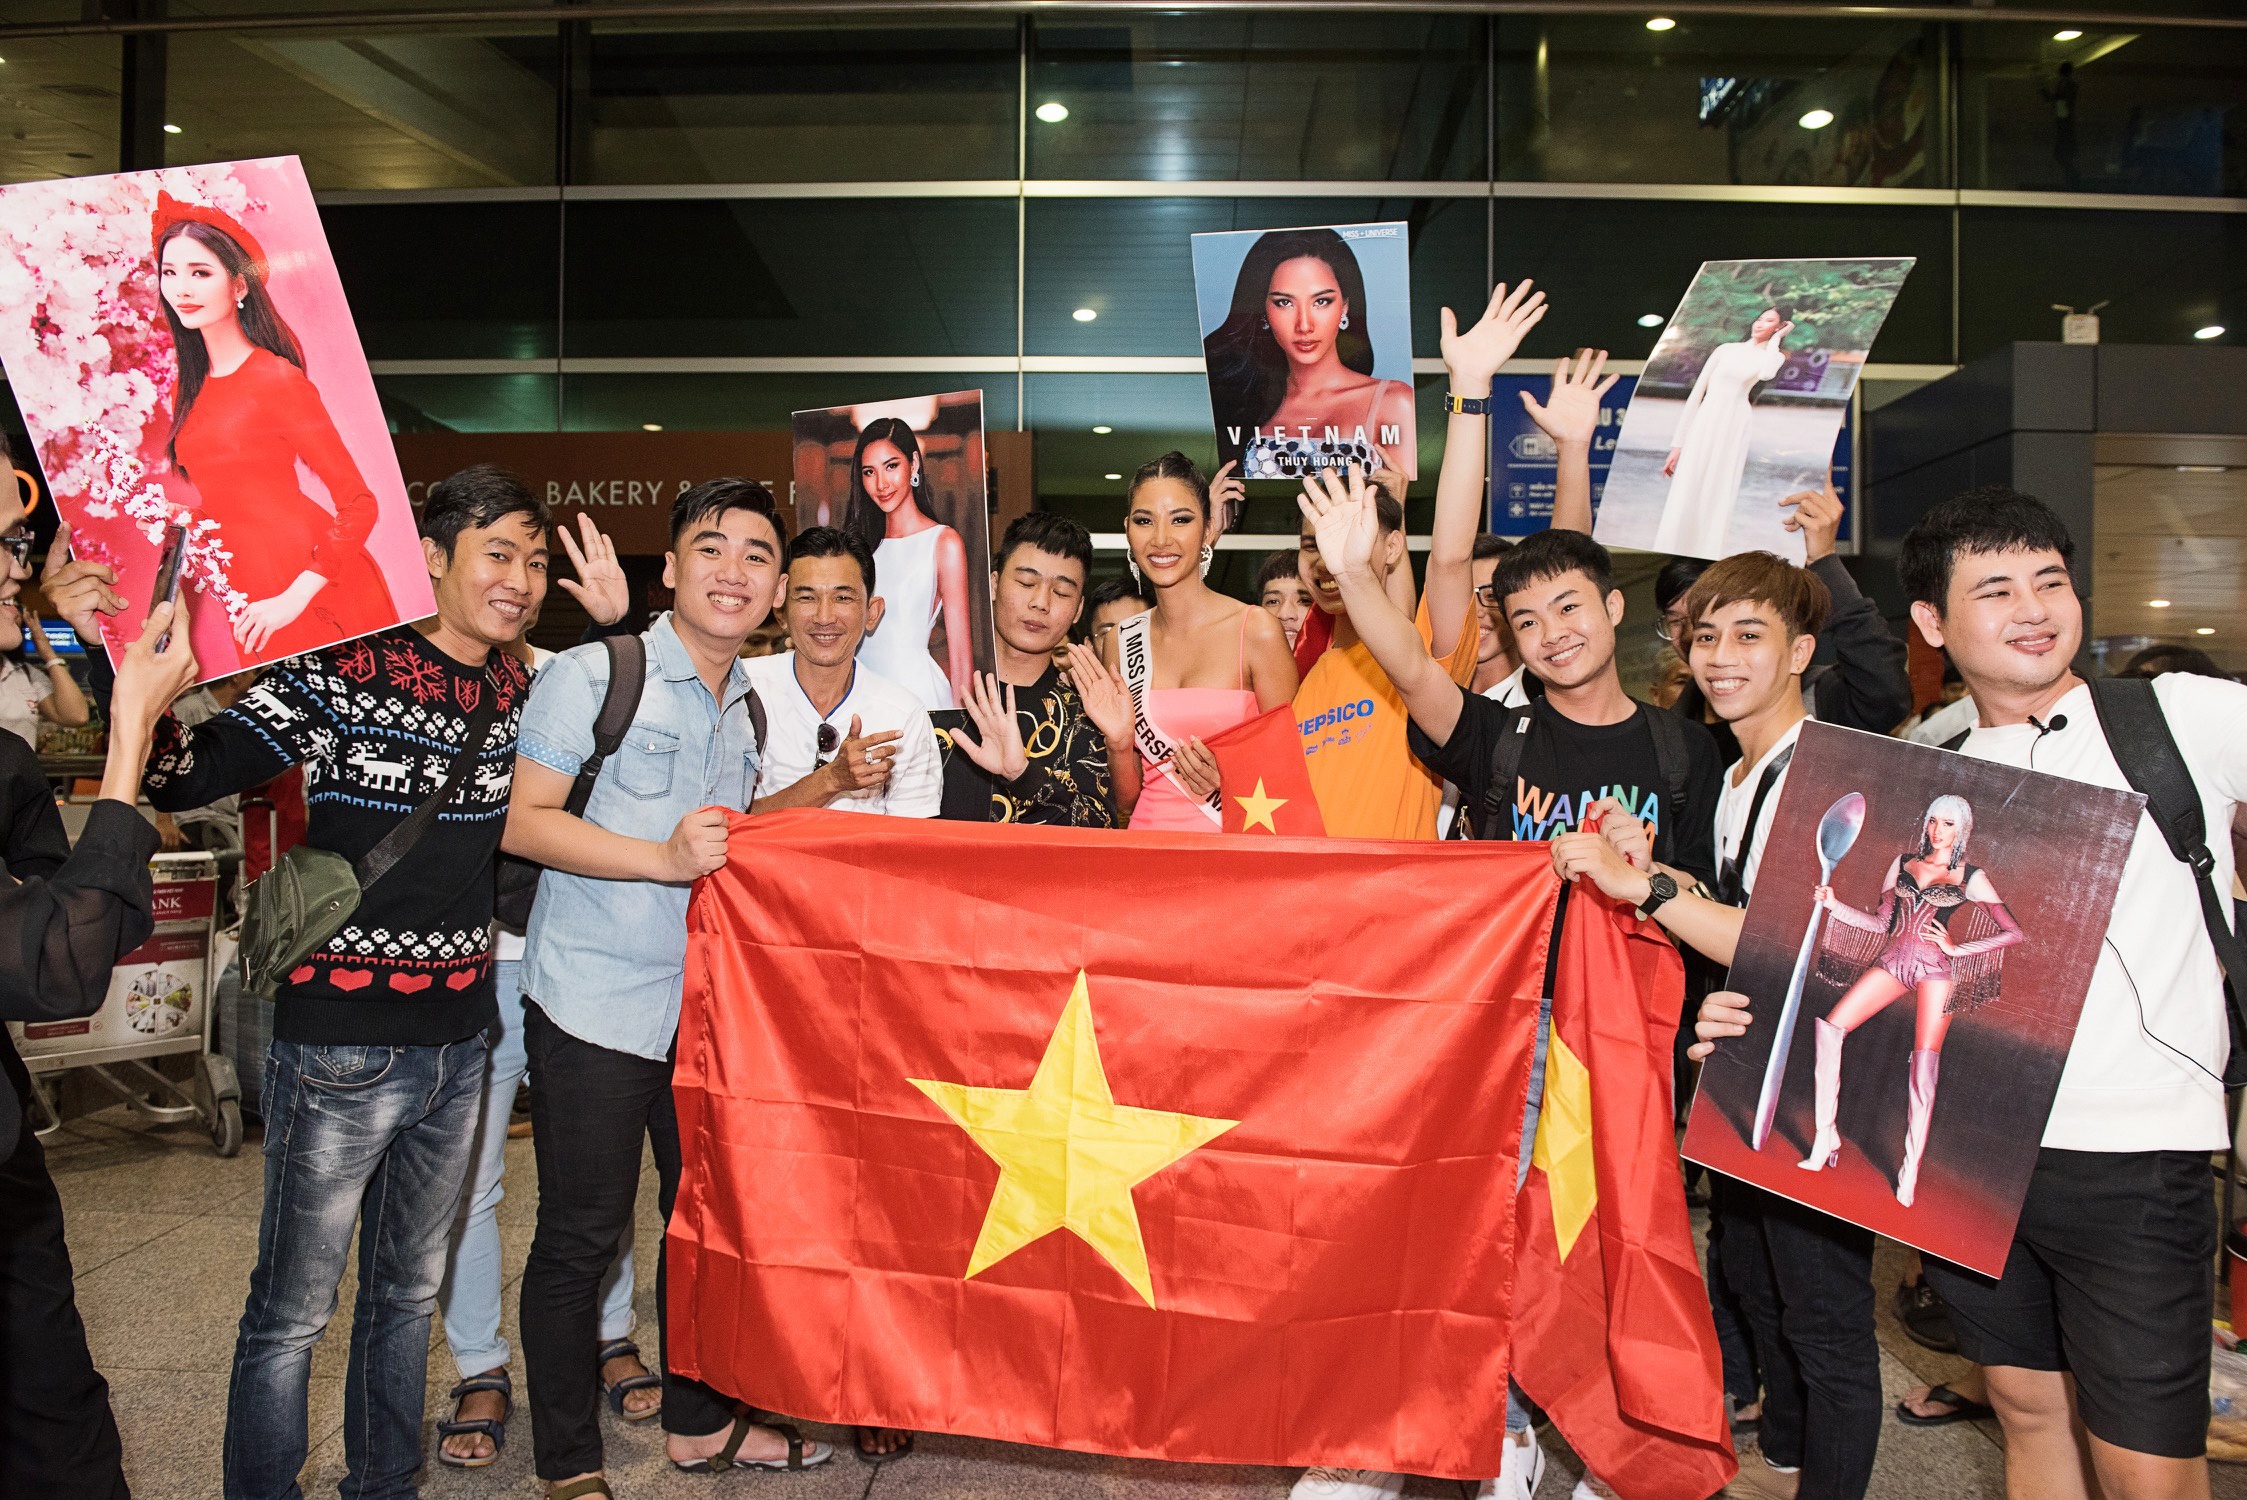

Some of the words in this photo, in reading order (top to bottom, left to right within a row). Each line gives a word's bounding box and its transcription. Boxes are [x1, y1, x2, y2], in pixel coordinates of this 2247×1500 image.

[1342, 230, 1359, 238] MISS
[1364, 227, 1398, 237] UNIVERSE
[1226, 424, 1400, 446] VIETNAM
[1278, 456, 1308, 467] THUY
[1312, 455, 1353, 467] HOANG
[546, 480, 663, 505] BAKERY
[1126, 632, 1146, 680] MISS
[1517, 775, 1659, 836] WANNA
